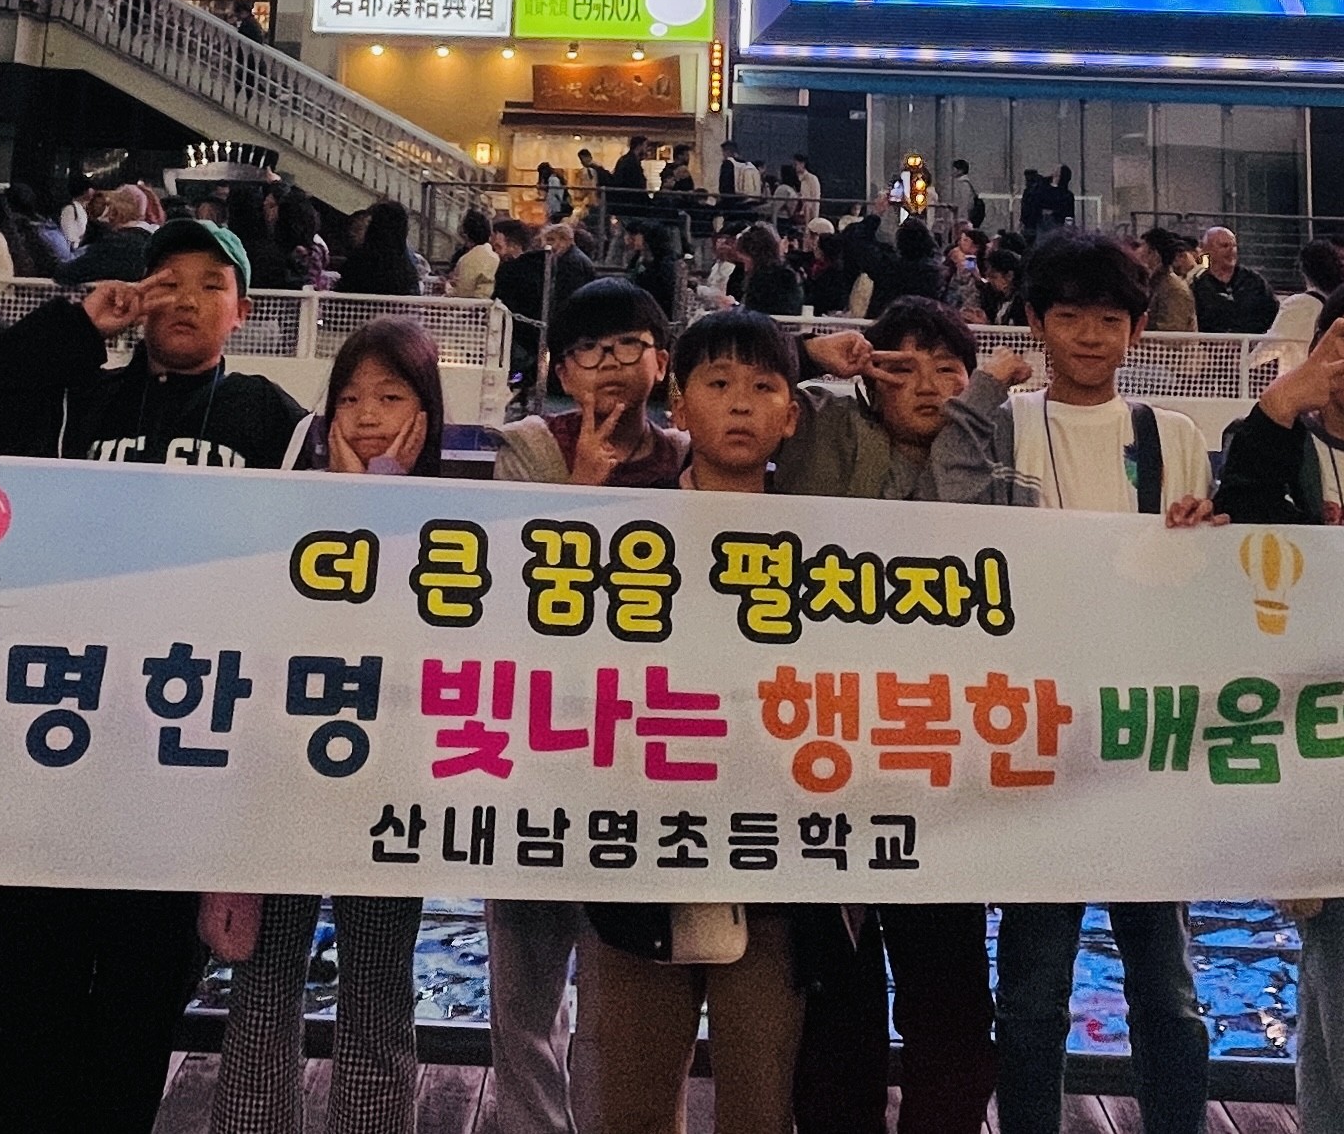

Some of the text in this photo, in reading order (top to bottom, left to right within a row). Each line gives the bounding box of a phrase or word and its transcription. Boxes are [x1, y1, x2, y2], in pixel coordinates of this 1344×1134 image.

[292, 521, 1013, 642] 더 큰 꿈을 펼치자!
[421, 659, 728, 781] 빛나는
[758, 666, 1072, 793] 행복한
[370, 804, 920, 872] 산내남명초등학교
